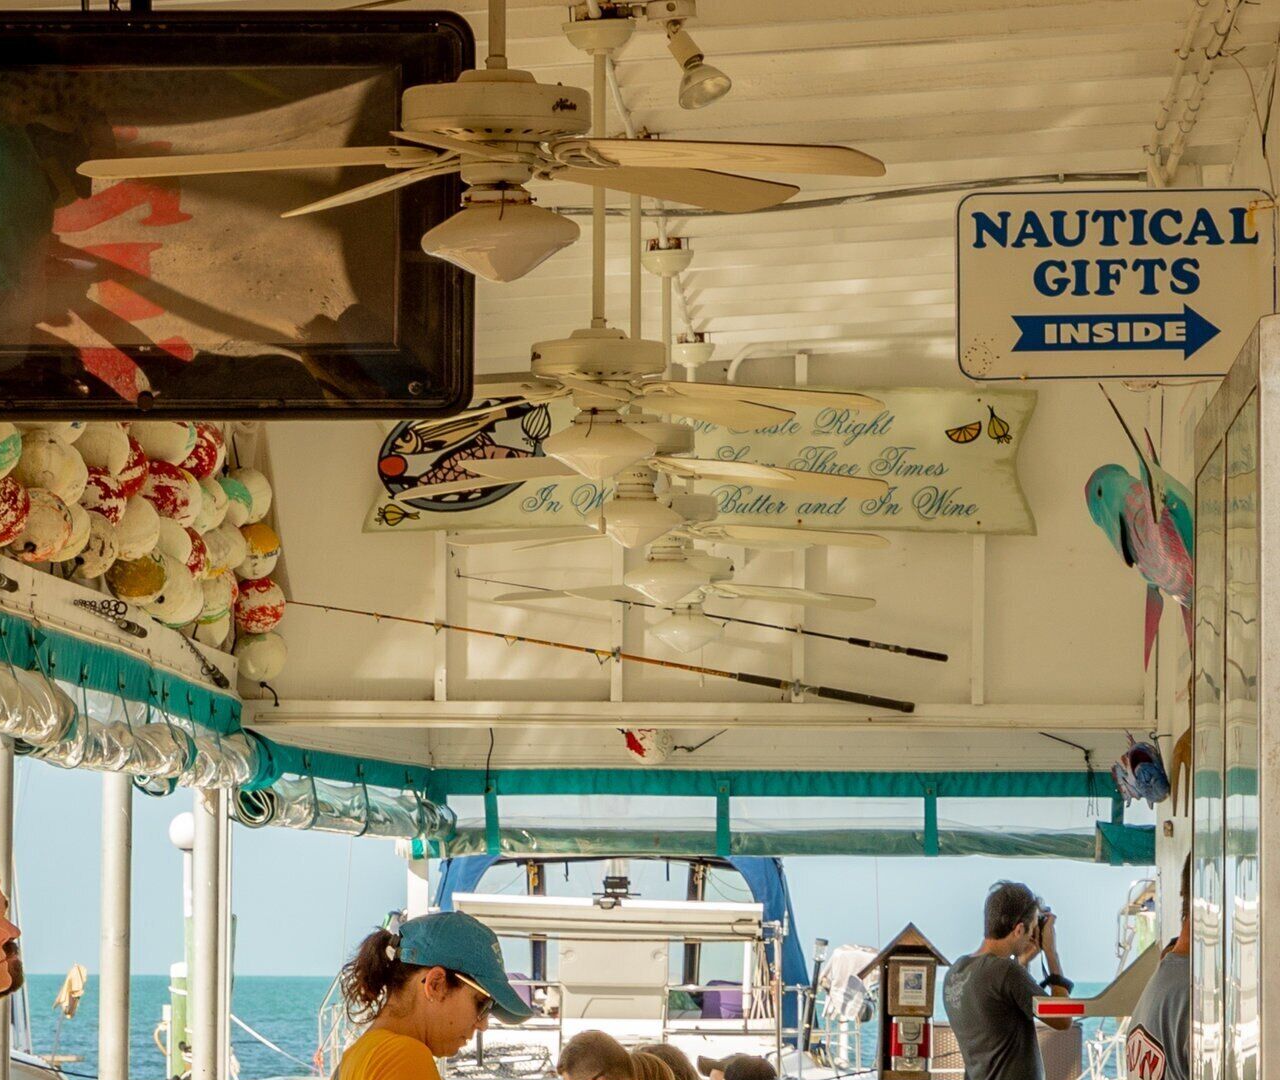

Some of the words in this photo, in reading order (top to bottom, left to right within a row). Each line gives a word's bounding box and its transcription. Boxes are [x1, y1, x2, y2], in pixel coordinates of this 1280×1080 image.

[971, 208, 1259, 248] NAUTICAL
[1033, 257, 1200, 297] GIFTS
[1045, 321, 1186, 344] INSIDE
[812, 405, 897, 447] Right
[870, 446, 950, 477] Times
[796, 496, 848, 516] and
[912, 486, 980, 520] Wine
